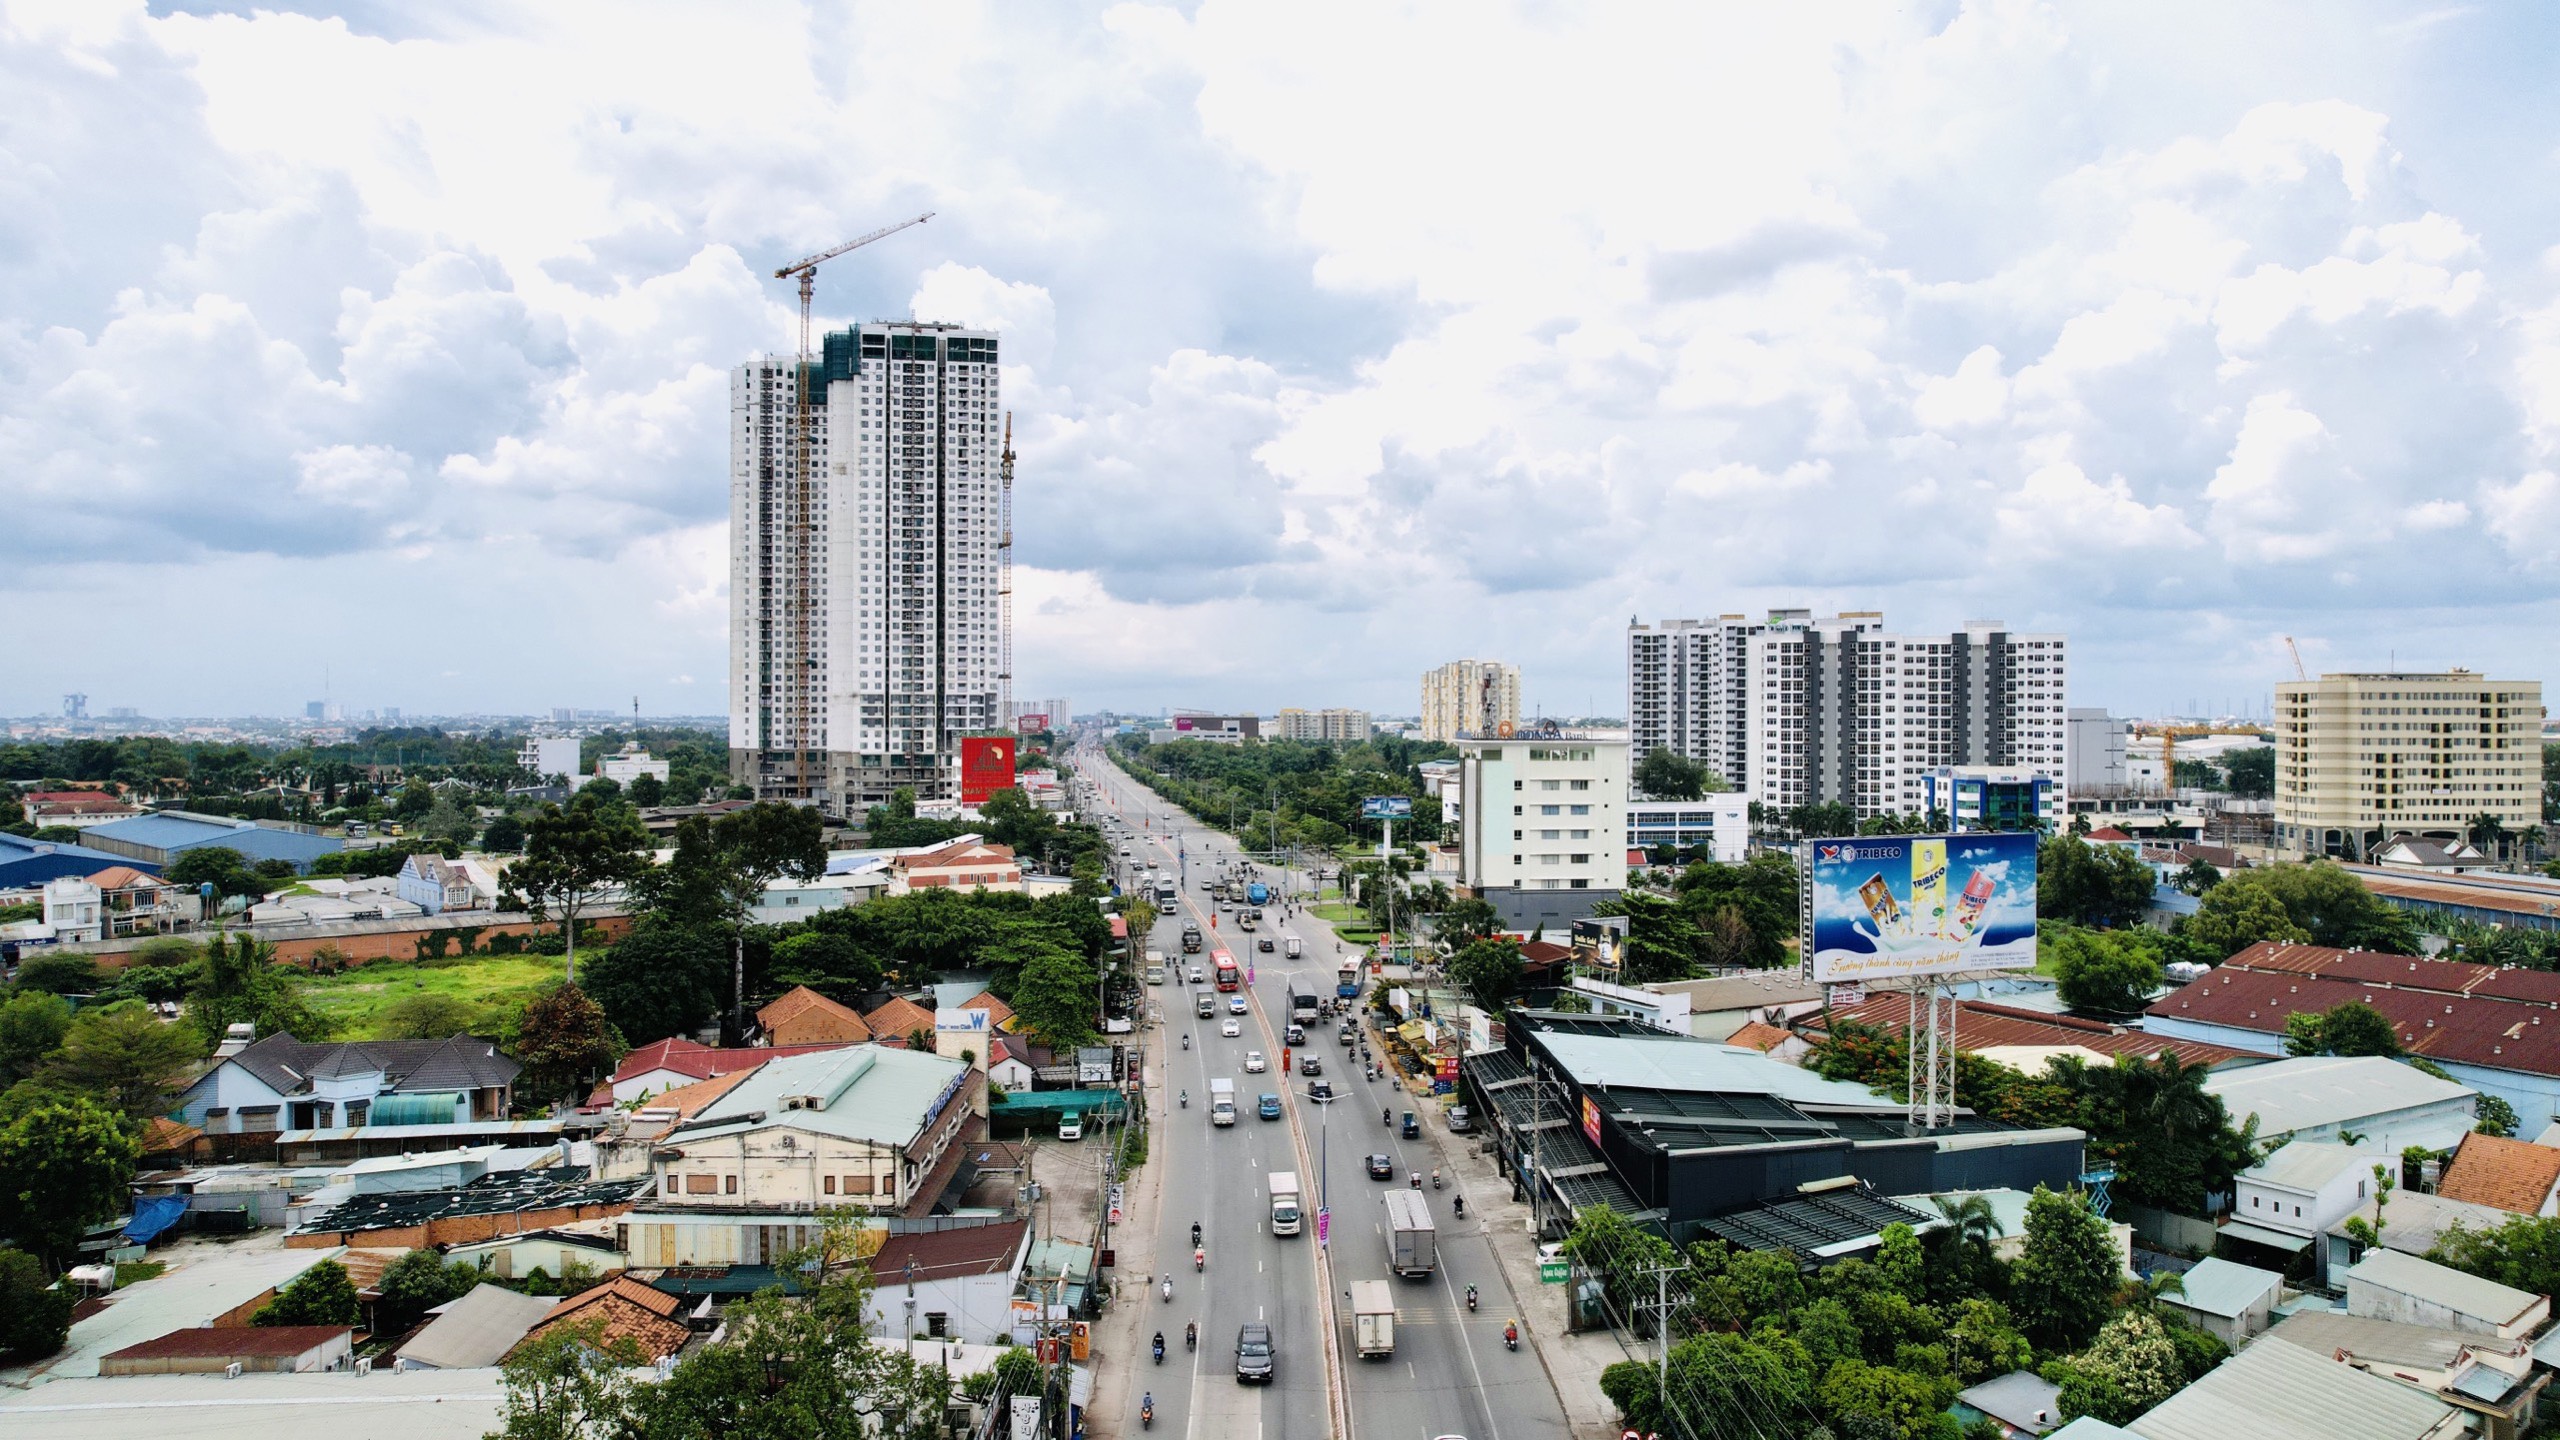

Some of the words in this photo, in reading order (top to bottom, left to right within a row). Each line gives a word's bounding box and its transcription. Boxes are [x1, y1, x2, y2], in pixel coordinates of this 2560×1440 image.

[1855, 847, 1902, 860] TRIBECO
[1912, 866, 1945, 888] TRIBECO
[1962, 892, 1987, 904] TRIBECO
[1866, 956, 1890, 968] thành
[1892, 958, 1912, 972] cùng
[1915, 957, 1935, 967] năm
[1936, 950, 1960, 965] tháng
[970, 1013, 986, 1030] W
